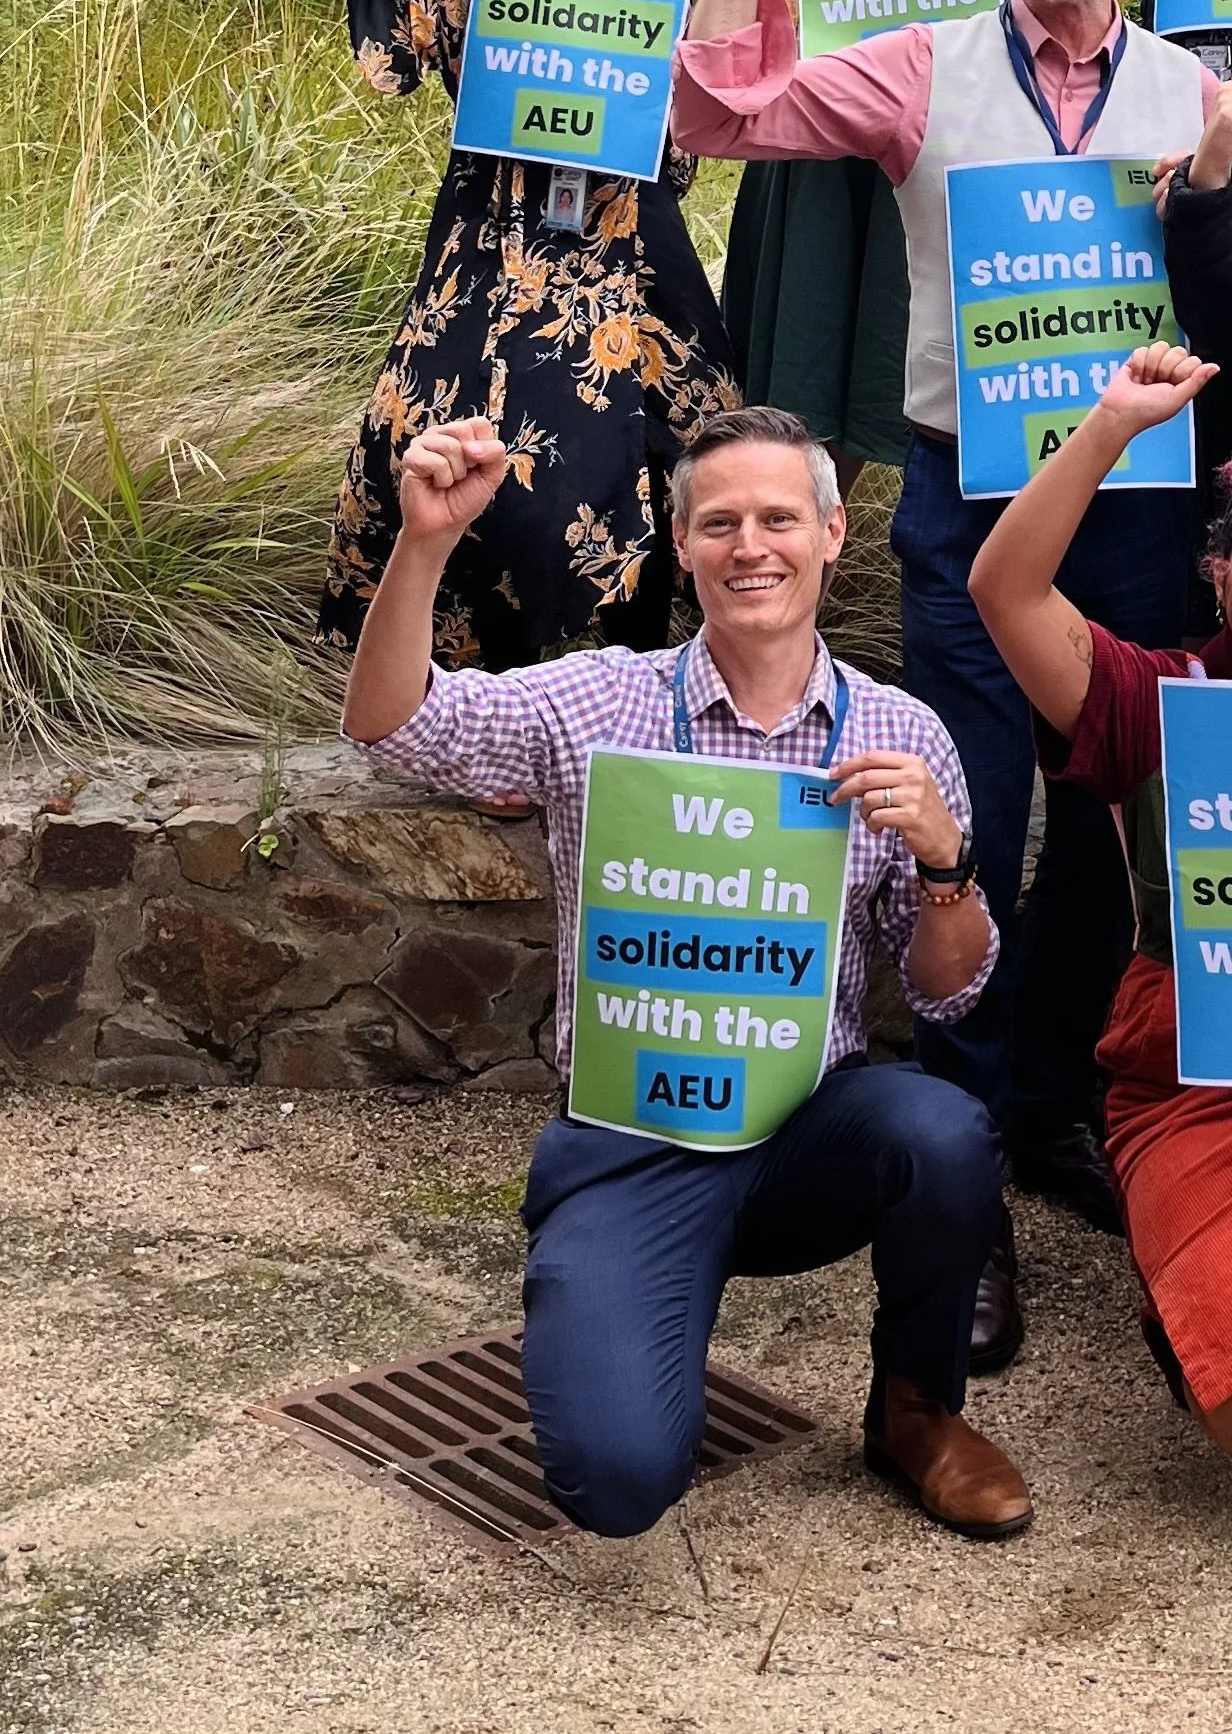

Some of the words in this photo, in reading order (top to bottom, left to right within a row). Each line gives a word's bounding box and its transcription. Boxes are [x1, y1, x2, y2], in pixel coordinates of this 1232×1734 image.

[486, 42, 572, 81] with
[584, 59, 648, 95] the
[522, 106, 593, 136] AEU
[1022, 191, 1094, 221] We
[970, 245, 1102, 287] stand
[1112, 242, 1152, 277] in
[974, 299, 1165, 348] solidarity
[980, 362, 1078, 402] with
[672, 794, 753, 839] We
[601, 858, 749, 909] stand
[760, 868, 809, 913] in
[597, 930, 814, 986] solidarity
[597, 992, 702, 1041] with
[714, 1005, 800, 1048] the
[647, 1072, 731, 1110] AEU
